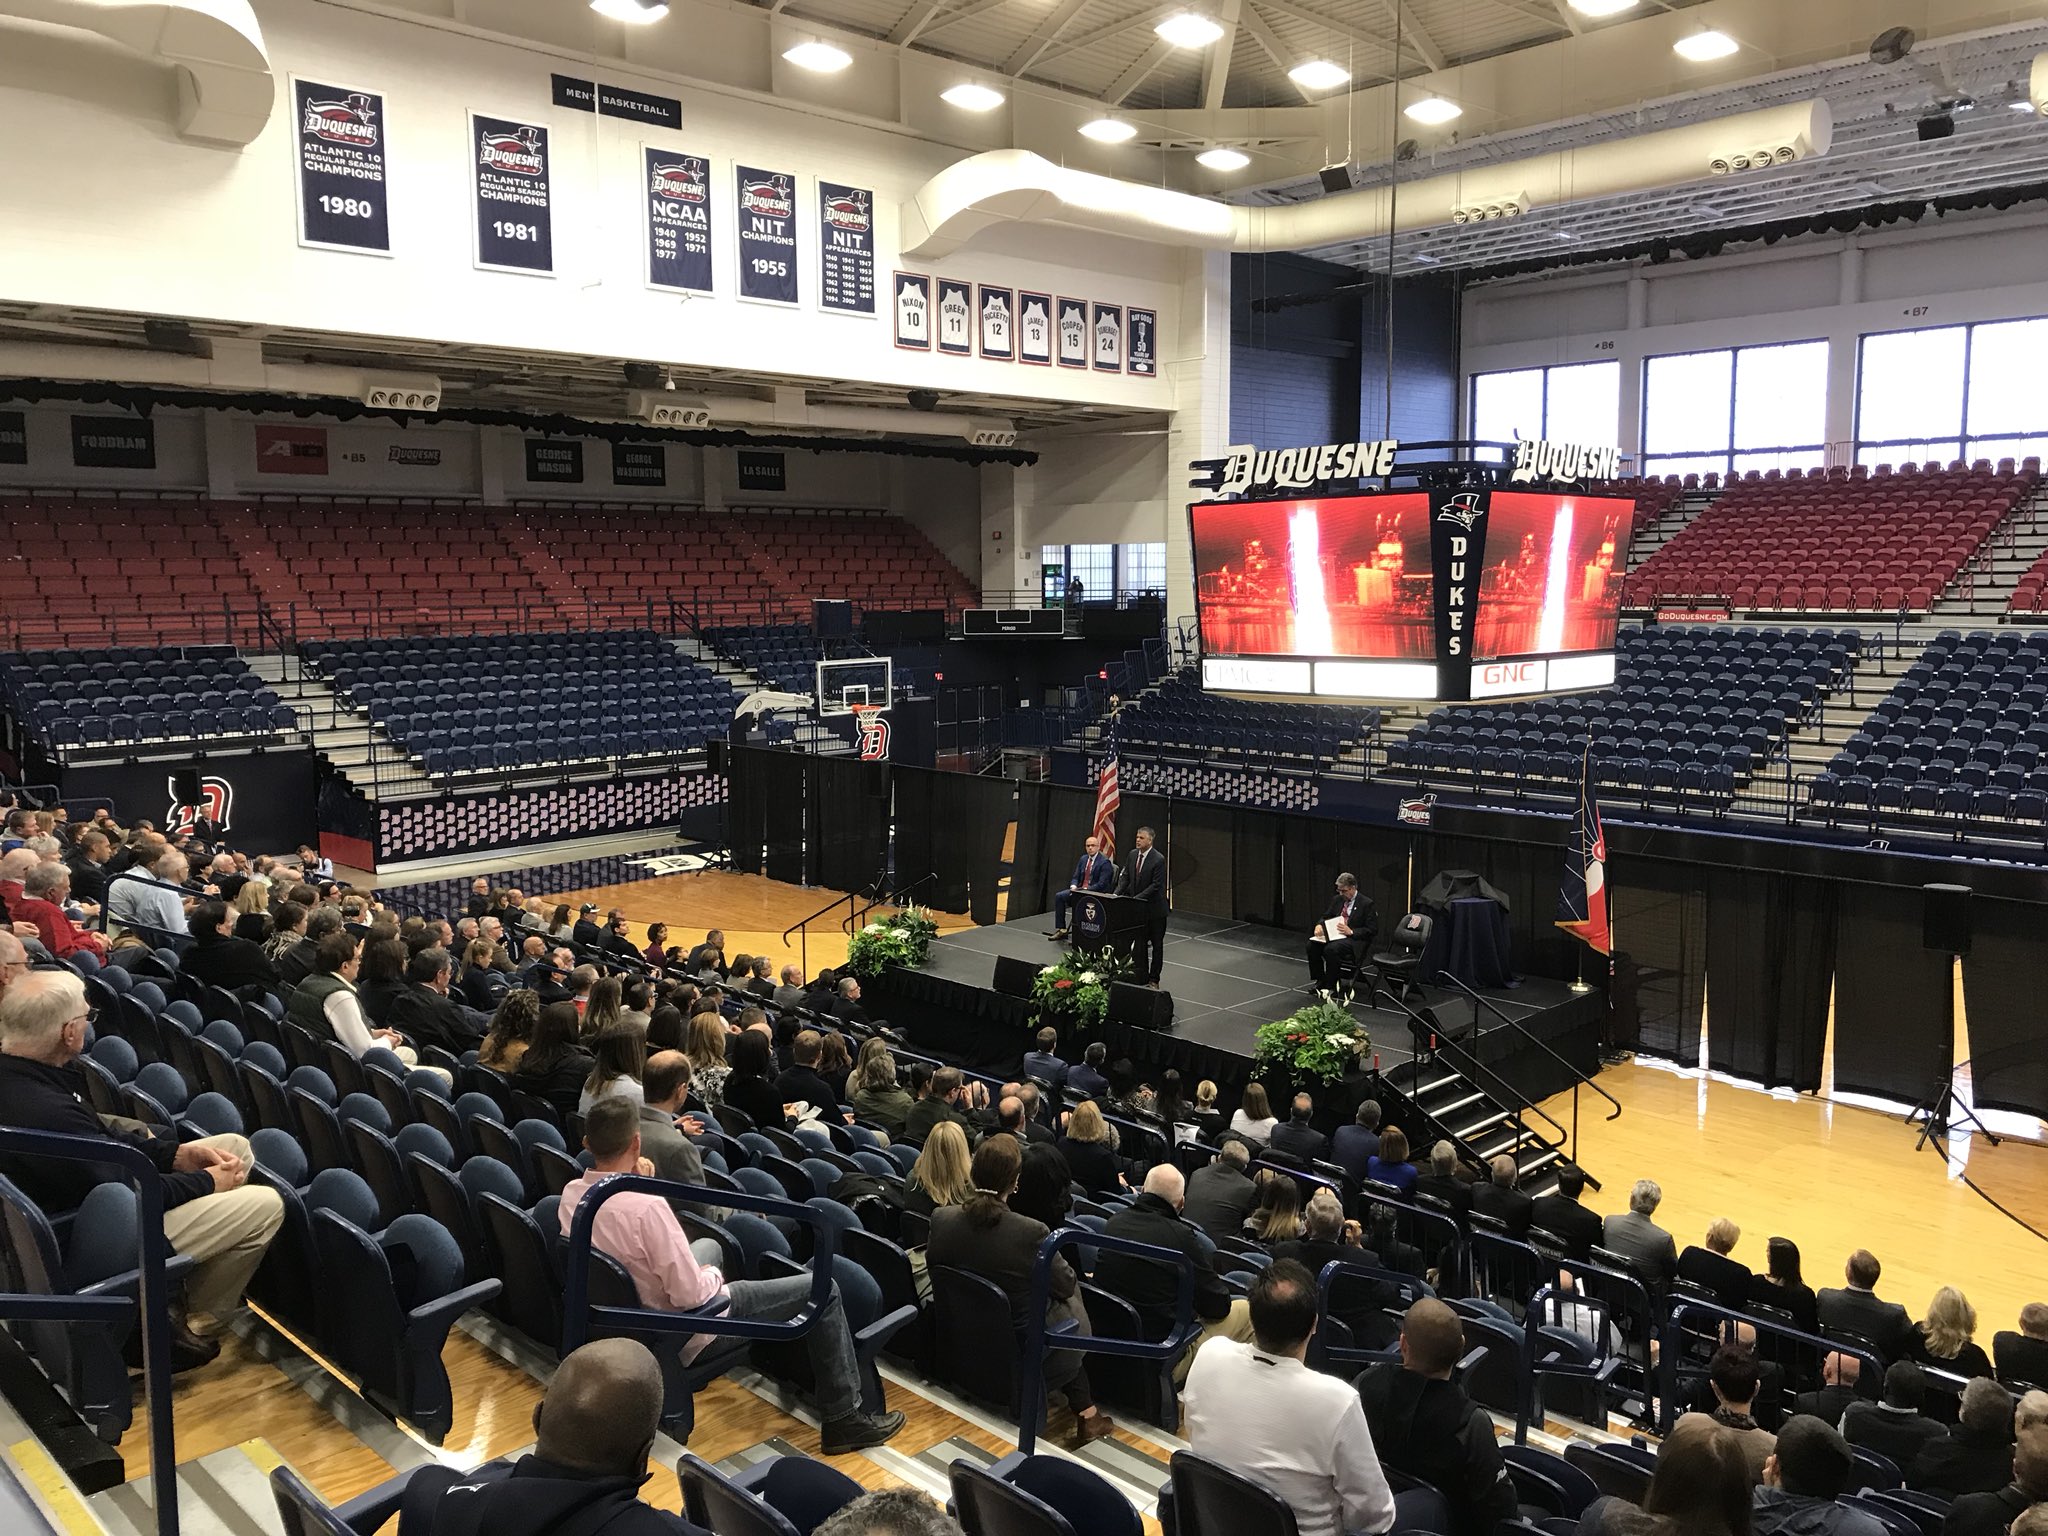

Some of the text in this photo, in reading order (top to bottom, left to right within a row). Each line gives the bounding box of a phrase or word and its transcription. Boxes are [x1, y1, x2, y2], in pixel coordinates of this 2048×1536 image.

[602, 96, 670, 116] BASKETBALL
[306, 112, 375, 138] DUQUESNE
[304, 143, 381, 163] ATLANTIC 10
[482, 145, 541, 167] DUQUESNE
[304, 152, 382, 171] REGULAR SEASON
[304, 161, 382, 181] CHAMPIONS
[480, 173, 546, 190] ATLANTIC 10
[653, 176, 704, 196] DUQUESNE
[480, 182, 547, 197] REGULAR SEASON
[480, 189, 547, 207] CHAMPIONS
[743, 192, 790, 211] DUQUESNE
[318, 195, 372, 218] 1980
[652, 200, 707, 223] NCAA
[826, 207, 867, 224] DUQUESNE
[652, 217, 708, 230] APPEARANCES
[752, 217, 785, 236] NIT
[493, 221, 537, 242] 1981
[654, 227, 706, 243] 1940 1952
[742, 230, 794, 246] CHAMPIONS
[654, 238, 706, 254] 1969 1971
[833, 231, 864, 248] NIT
[655, 249, 677, 260] 1977
[825, 244, 871, 257] APPEARANCES
[751, 258, 787, 277] 1955
[902, 297, 924, 310] NIXON
[944, 304, 966, 316] GREEN
[1912, 306, 1929, 317] B7
[907, 312, 920, 327] 10
[950, 318, 961, 332] 11
[1027, 317, 1044, 327] JAMES
[1061, 320, 1083, 333] COOPER
[992, 323, 1002, 335] 12
[1031, 328, 1040, 341] 13
[1067, 333, 1079, 347] 15
[1102, 338, 1114, 351] 24
[1137, 341, 1146, 352] 50
[1601, 341, 1614, 350] B6
[80, 434, 147, 449] FORDHAM
[351, 453, 366, 463] B5
[389, 446, 441, 463] DUQUESNE
[535, 448, 574, 461] GEORGE
[625, 453, 653, 465] GEORGE
[1511, 439, 1623, 484] DUQUESNE
[537, 461, 573, 474] MASON
[616, 466, 663, 479] WASHINGTON
[743, 465, 781, 477] LA SALLE
[1217, 440, 1398, 497] DUQUESNE
[1448, 536, 1467, 655] DUKES
[1484, 663, 1535, 684] GNC
[1400, 807, 1431, 820] DUQUES
